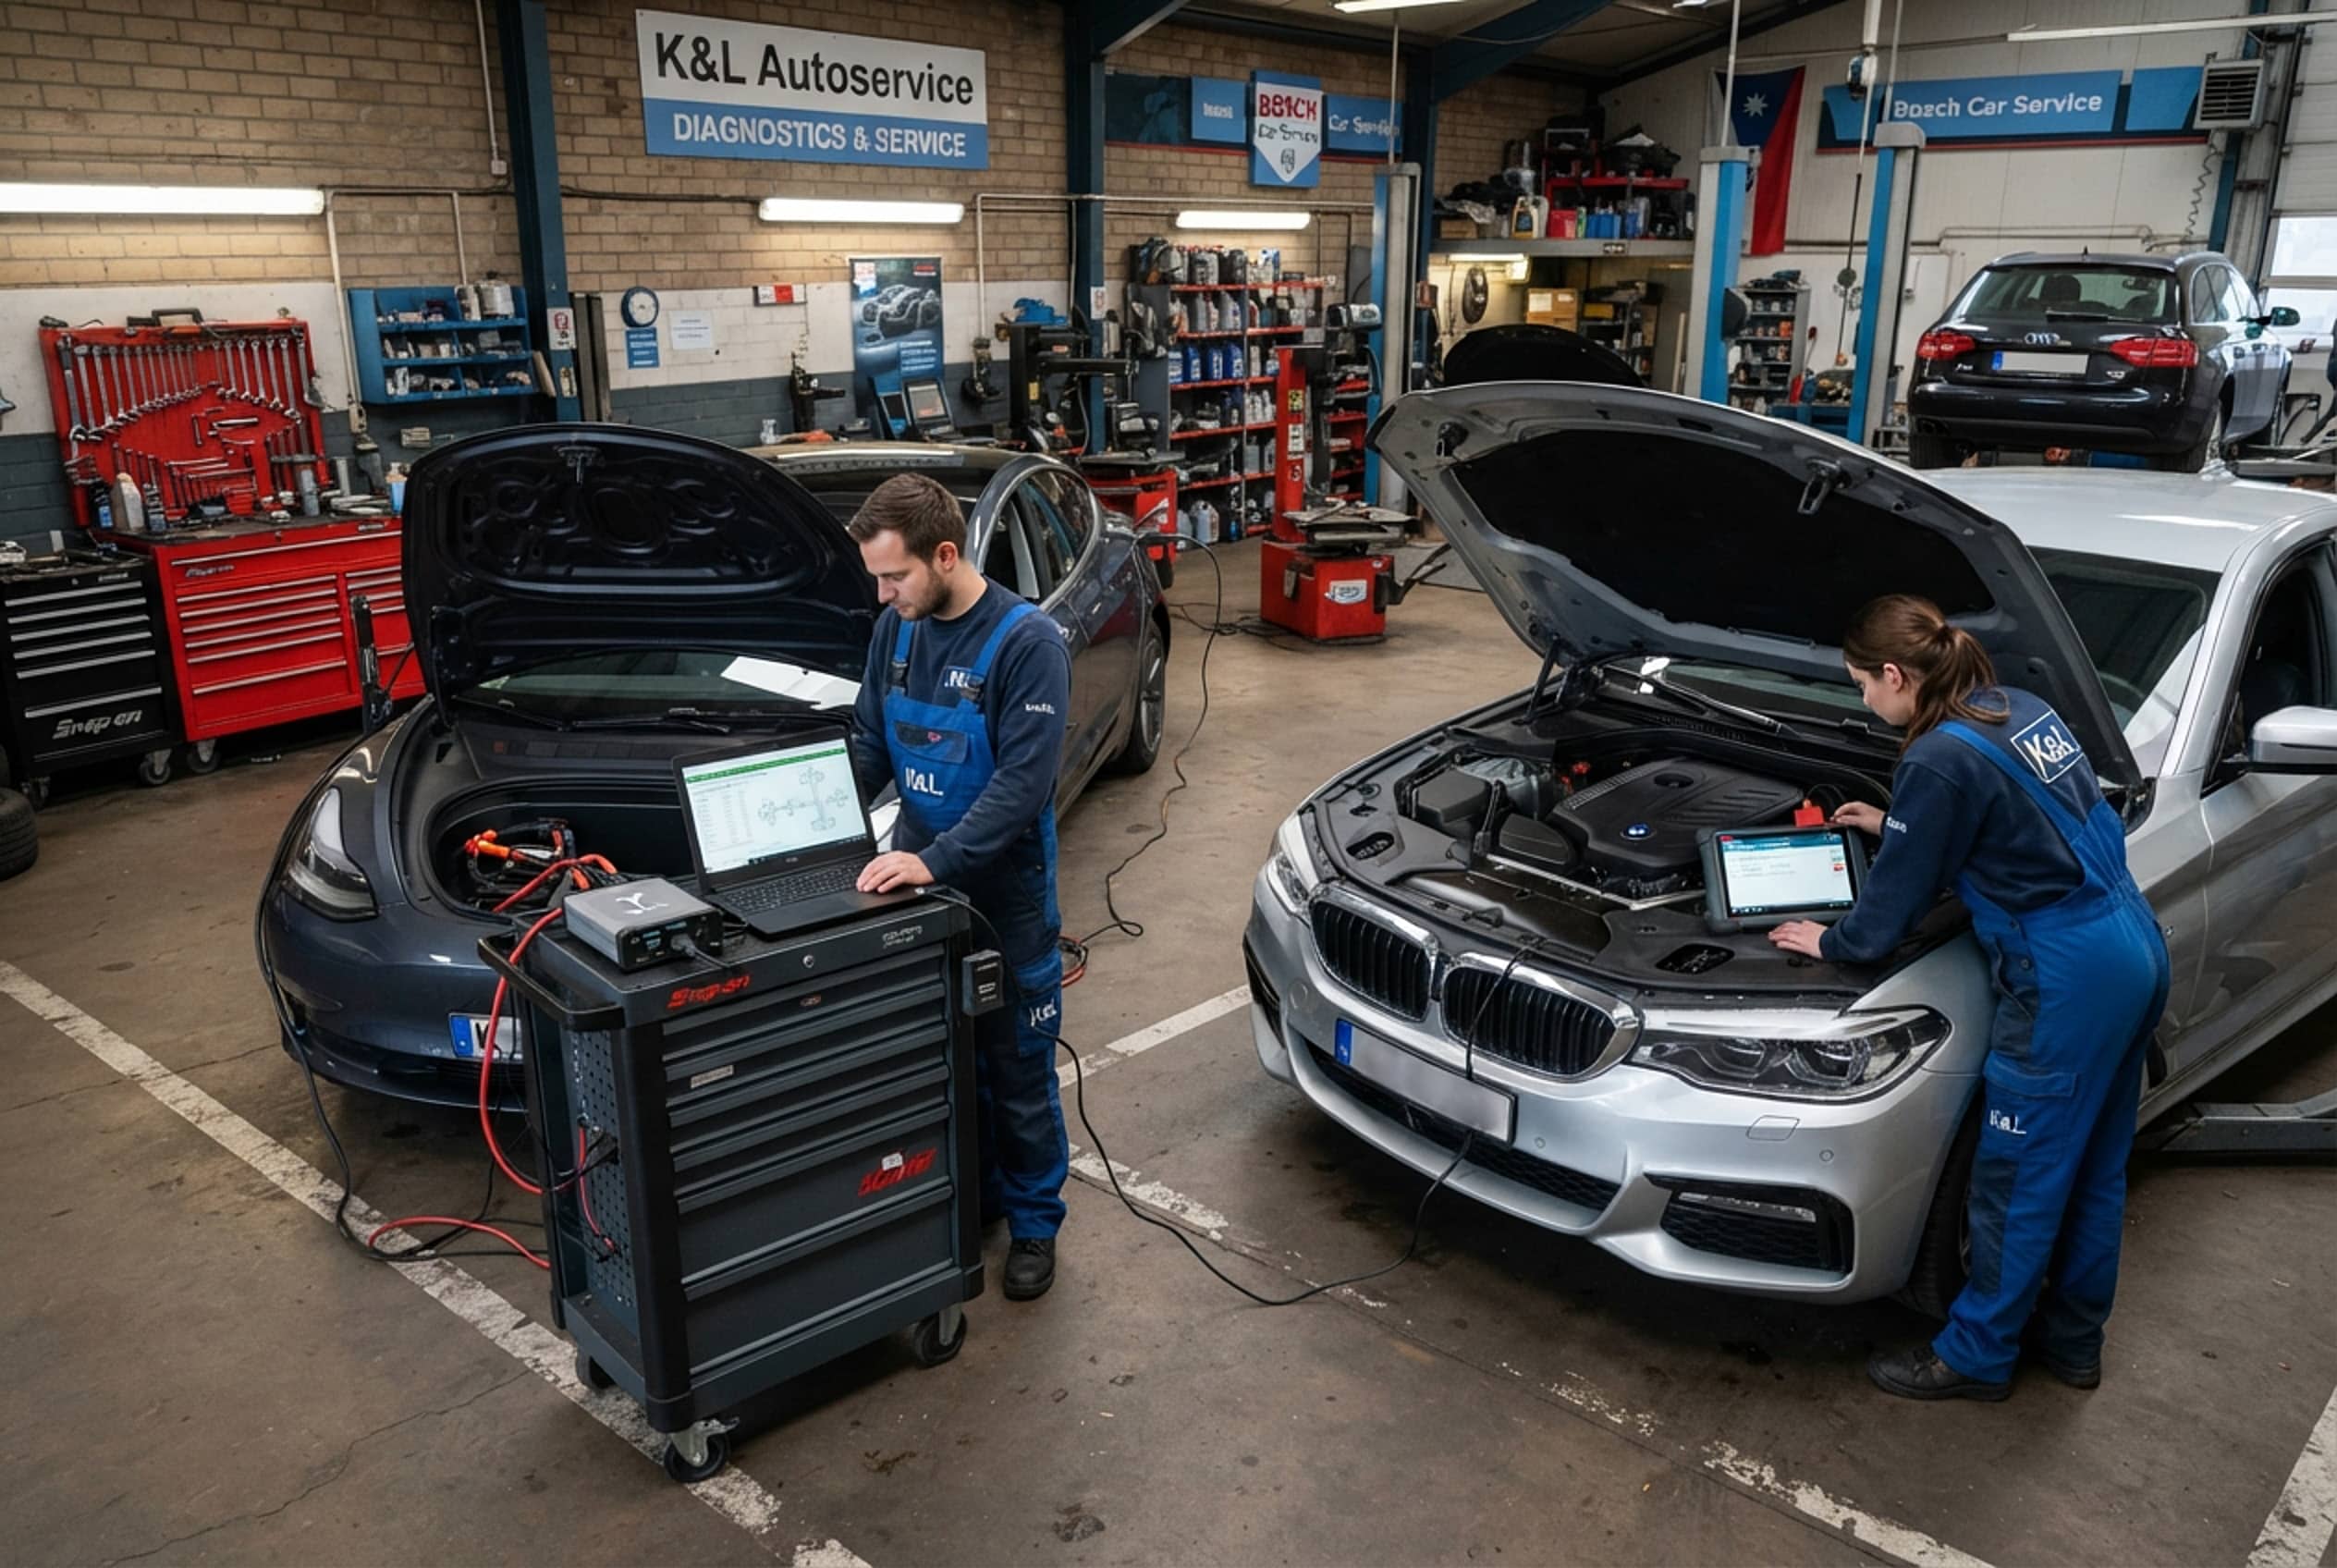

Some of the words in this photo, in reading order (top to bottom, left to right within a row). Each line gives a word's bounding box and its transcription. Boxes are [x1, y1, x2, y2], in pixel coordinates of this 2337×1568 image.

[655, 31, 746, 85] K&L
[757, 43, 974, 105] Autoservice
[1967, 96, 2007, 116] Car
[2013, 92, 2103, 115] Service
[673, 113, 846, 150] DIAGNOSTICS
[853, 126, 871, 153] &
[875, 129, 966, 158] SERVICE
